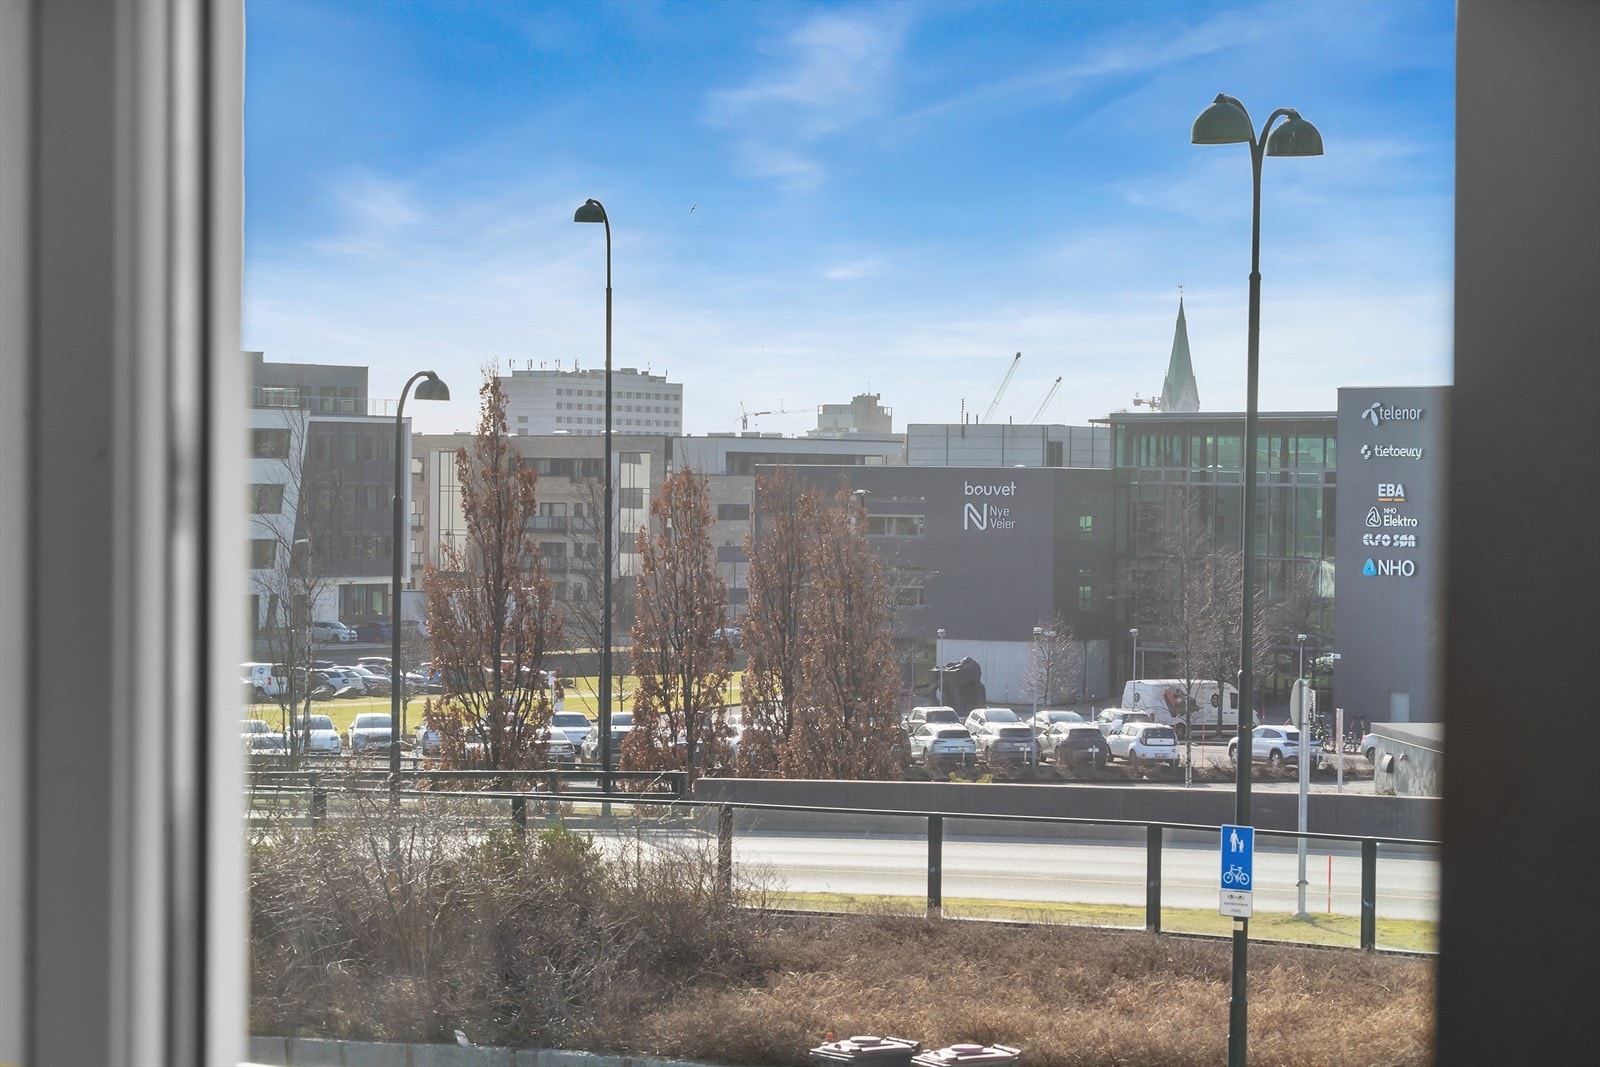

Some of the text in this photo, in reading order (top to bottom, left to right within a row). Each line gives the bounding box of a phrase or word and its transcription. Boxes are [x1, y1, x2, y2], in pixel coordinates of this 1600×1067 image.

[1380, 405, 1422, 420] telenor
[1374, 444, 1422, 460] tietoevry
[964, 480, 1017, 496] bouvet
[1377, 483, 1405, 497] EBA
[990, 505, 1010, 519] Nye
[990, 518, 1016, 529] Veier
[1383, 515, 1418, 527] Elektro
[1378, 559, 1415, 577] NHO
